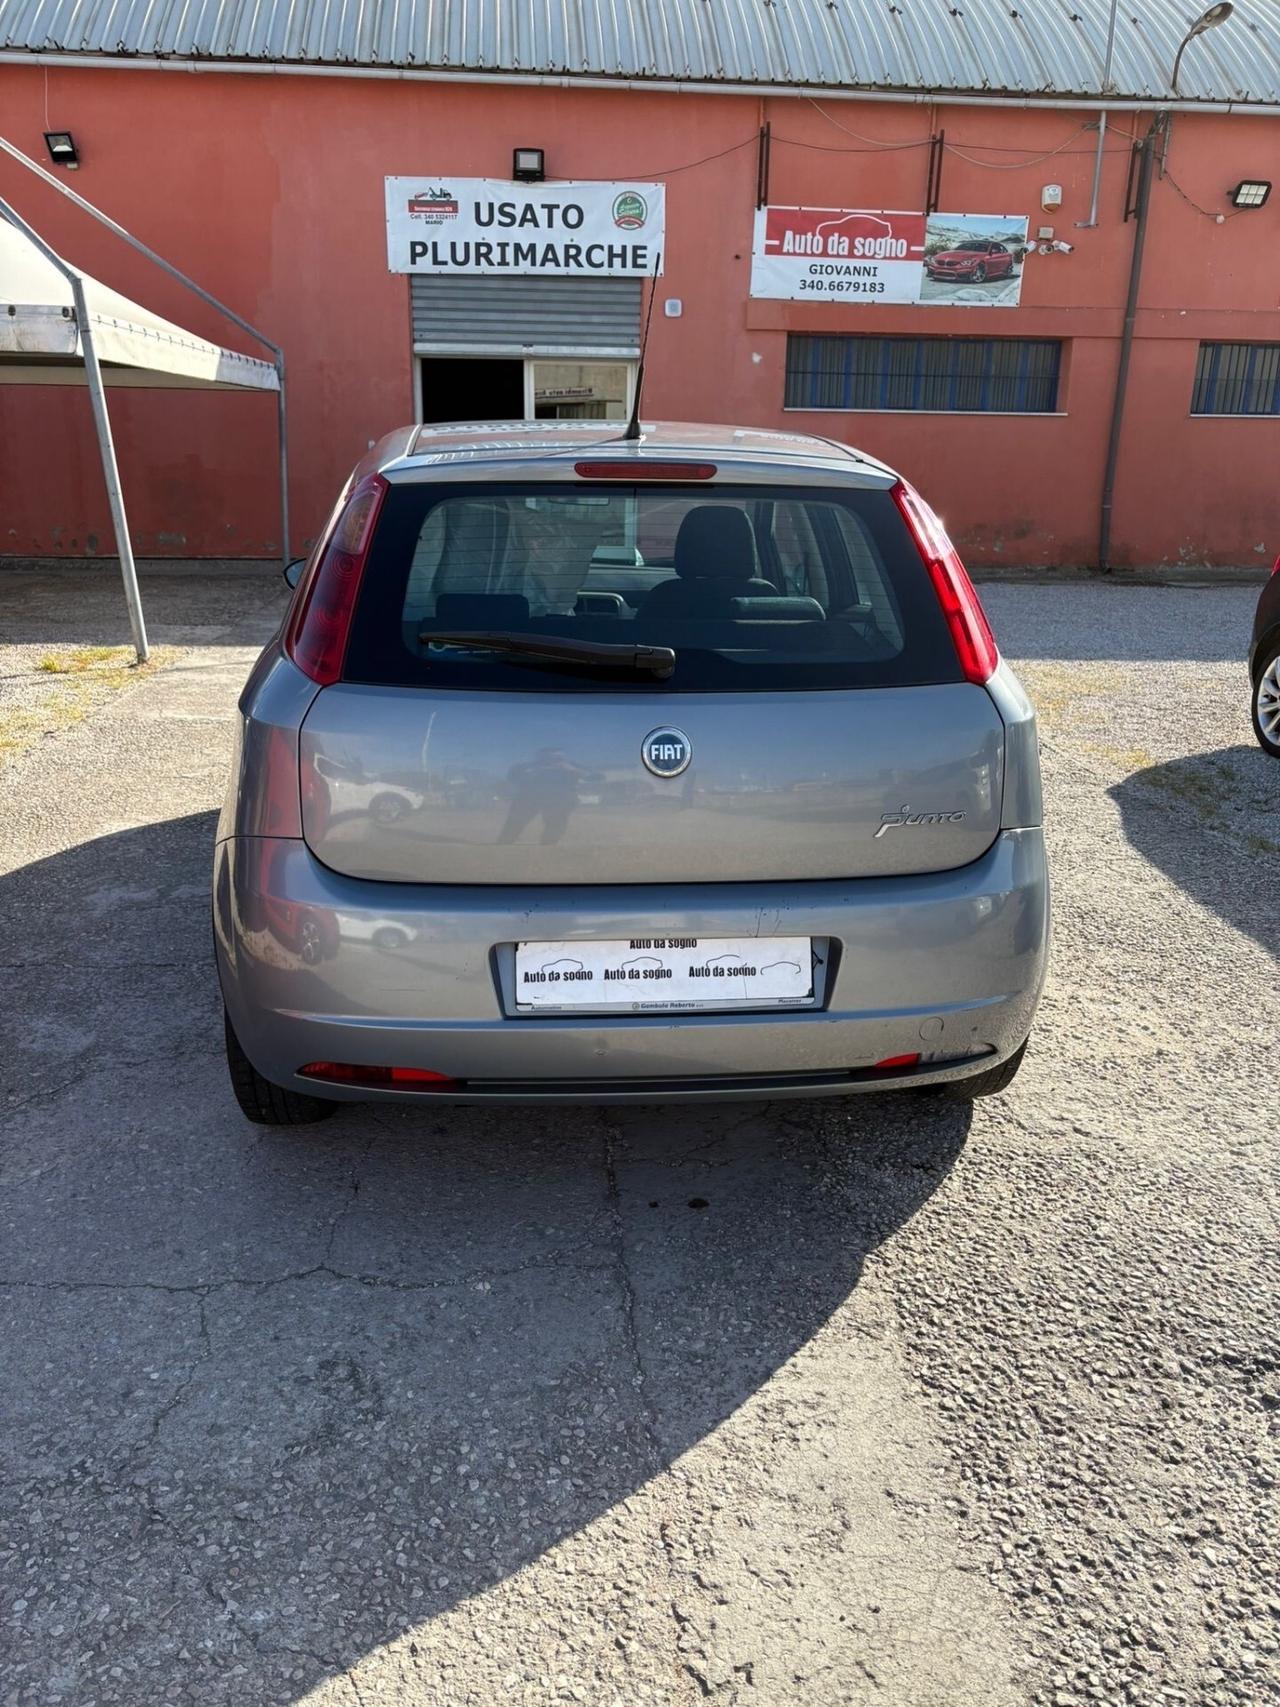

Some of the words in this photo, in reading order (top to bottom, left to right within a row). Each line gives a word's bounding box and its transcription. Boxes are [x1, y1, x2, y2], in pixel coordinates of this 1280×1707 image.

[474, 201, 584, 230] USATO
[782, 230, 823, 254] Auto
[827, 232, 850, 256] da
[854, 237, 908, 259] sogno
[409, 240, 648, 269] PLURIMARCHE
[809, 263, 878, 278] GIOVANNI
[799, 279, 885, 294] 340.6679183
[651, 744, 683, 760] FIAT
[630, 938, 652, 950] Auto
[668, 937, 698, 950] sogno
[524, 970, 547, 983] Auto
[548, 970, 561, 982] da
[604, 968, 626, 981] Auto
[628, 968, 640, 980] da
[642, 968, 672, 980] sogno
[689, 965, 711, 978] Auto
[712, 965, 725, 977] da
